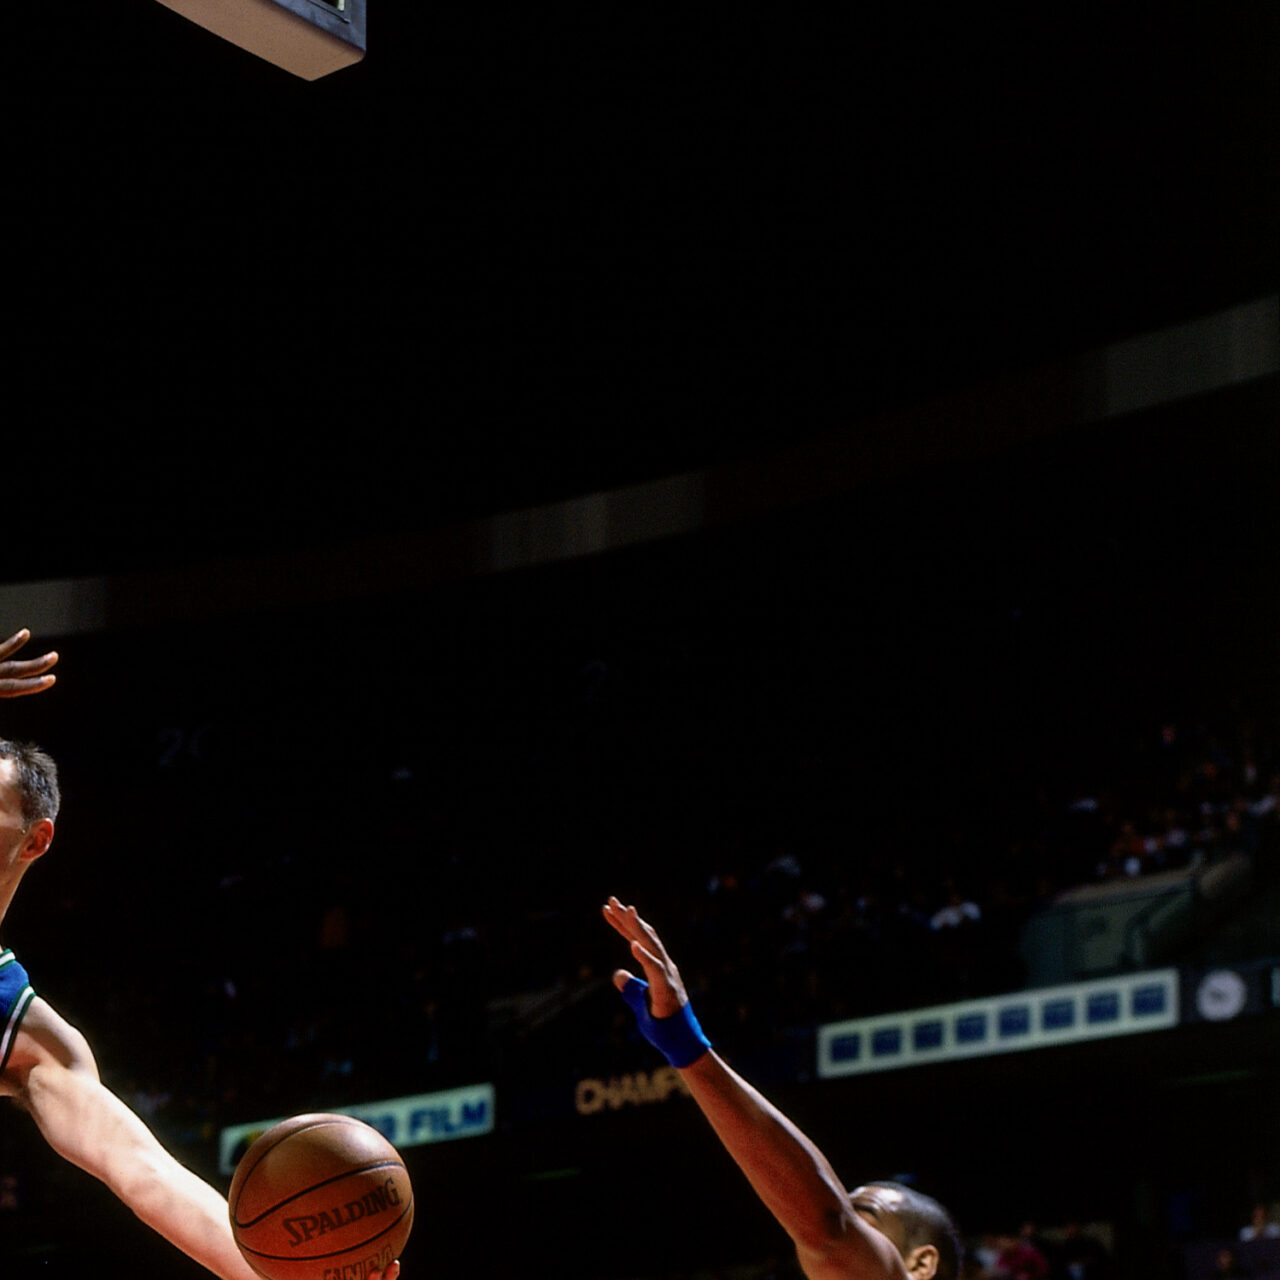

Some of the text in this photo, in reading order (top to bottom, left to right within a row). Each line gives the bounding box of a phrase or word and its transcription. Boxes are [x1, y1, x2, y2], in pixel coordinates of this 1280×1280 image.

[575, 1065, 692, 1116] CHAMP
[408, 1101, 486, 1135] FILM
[282, 1176, 402, 1248] SPALDING
